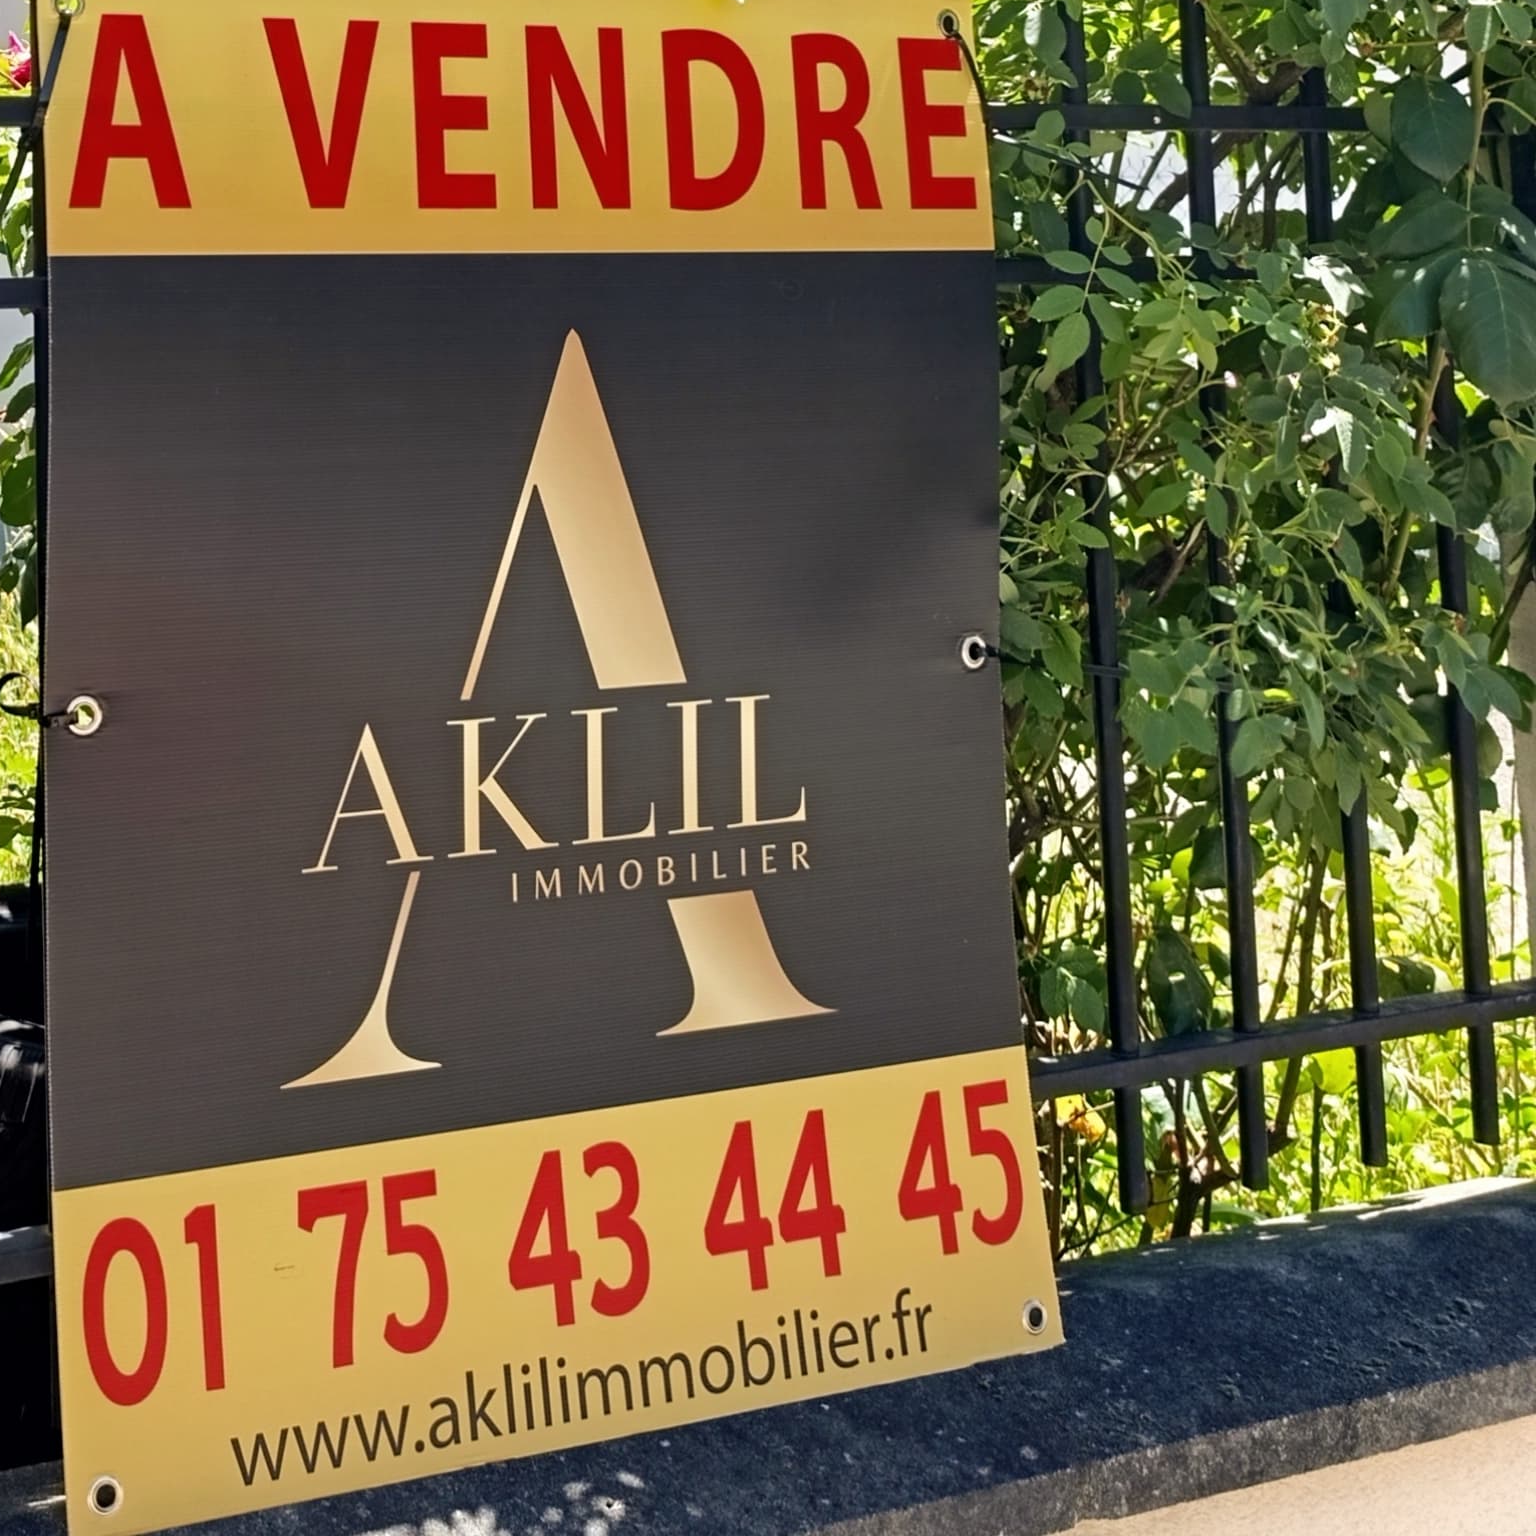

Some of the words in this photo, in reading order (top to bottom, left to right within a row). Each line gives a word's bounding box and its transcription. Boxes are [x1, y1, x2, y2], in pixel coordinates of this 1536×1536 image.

[68, 13, 193, 209] A
[262, 17, 978, 211] VENDRE
[301, 694, 807, 875] AKLIL
[511, 840, 811, 904] IMMOBILIER
[82, 1203, 226, 1407] 01
[297, 1168, 450, 1369] 75
[508, 1141, 652, 1327] 43
[703, 1108, 847, 1292] 44
[898, 1079, 1024, 1256] 45
[230, 1287, 934, 1487] www.aklilimmobilier.fr
